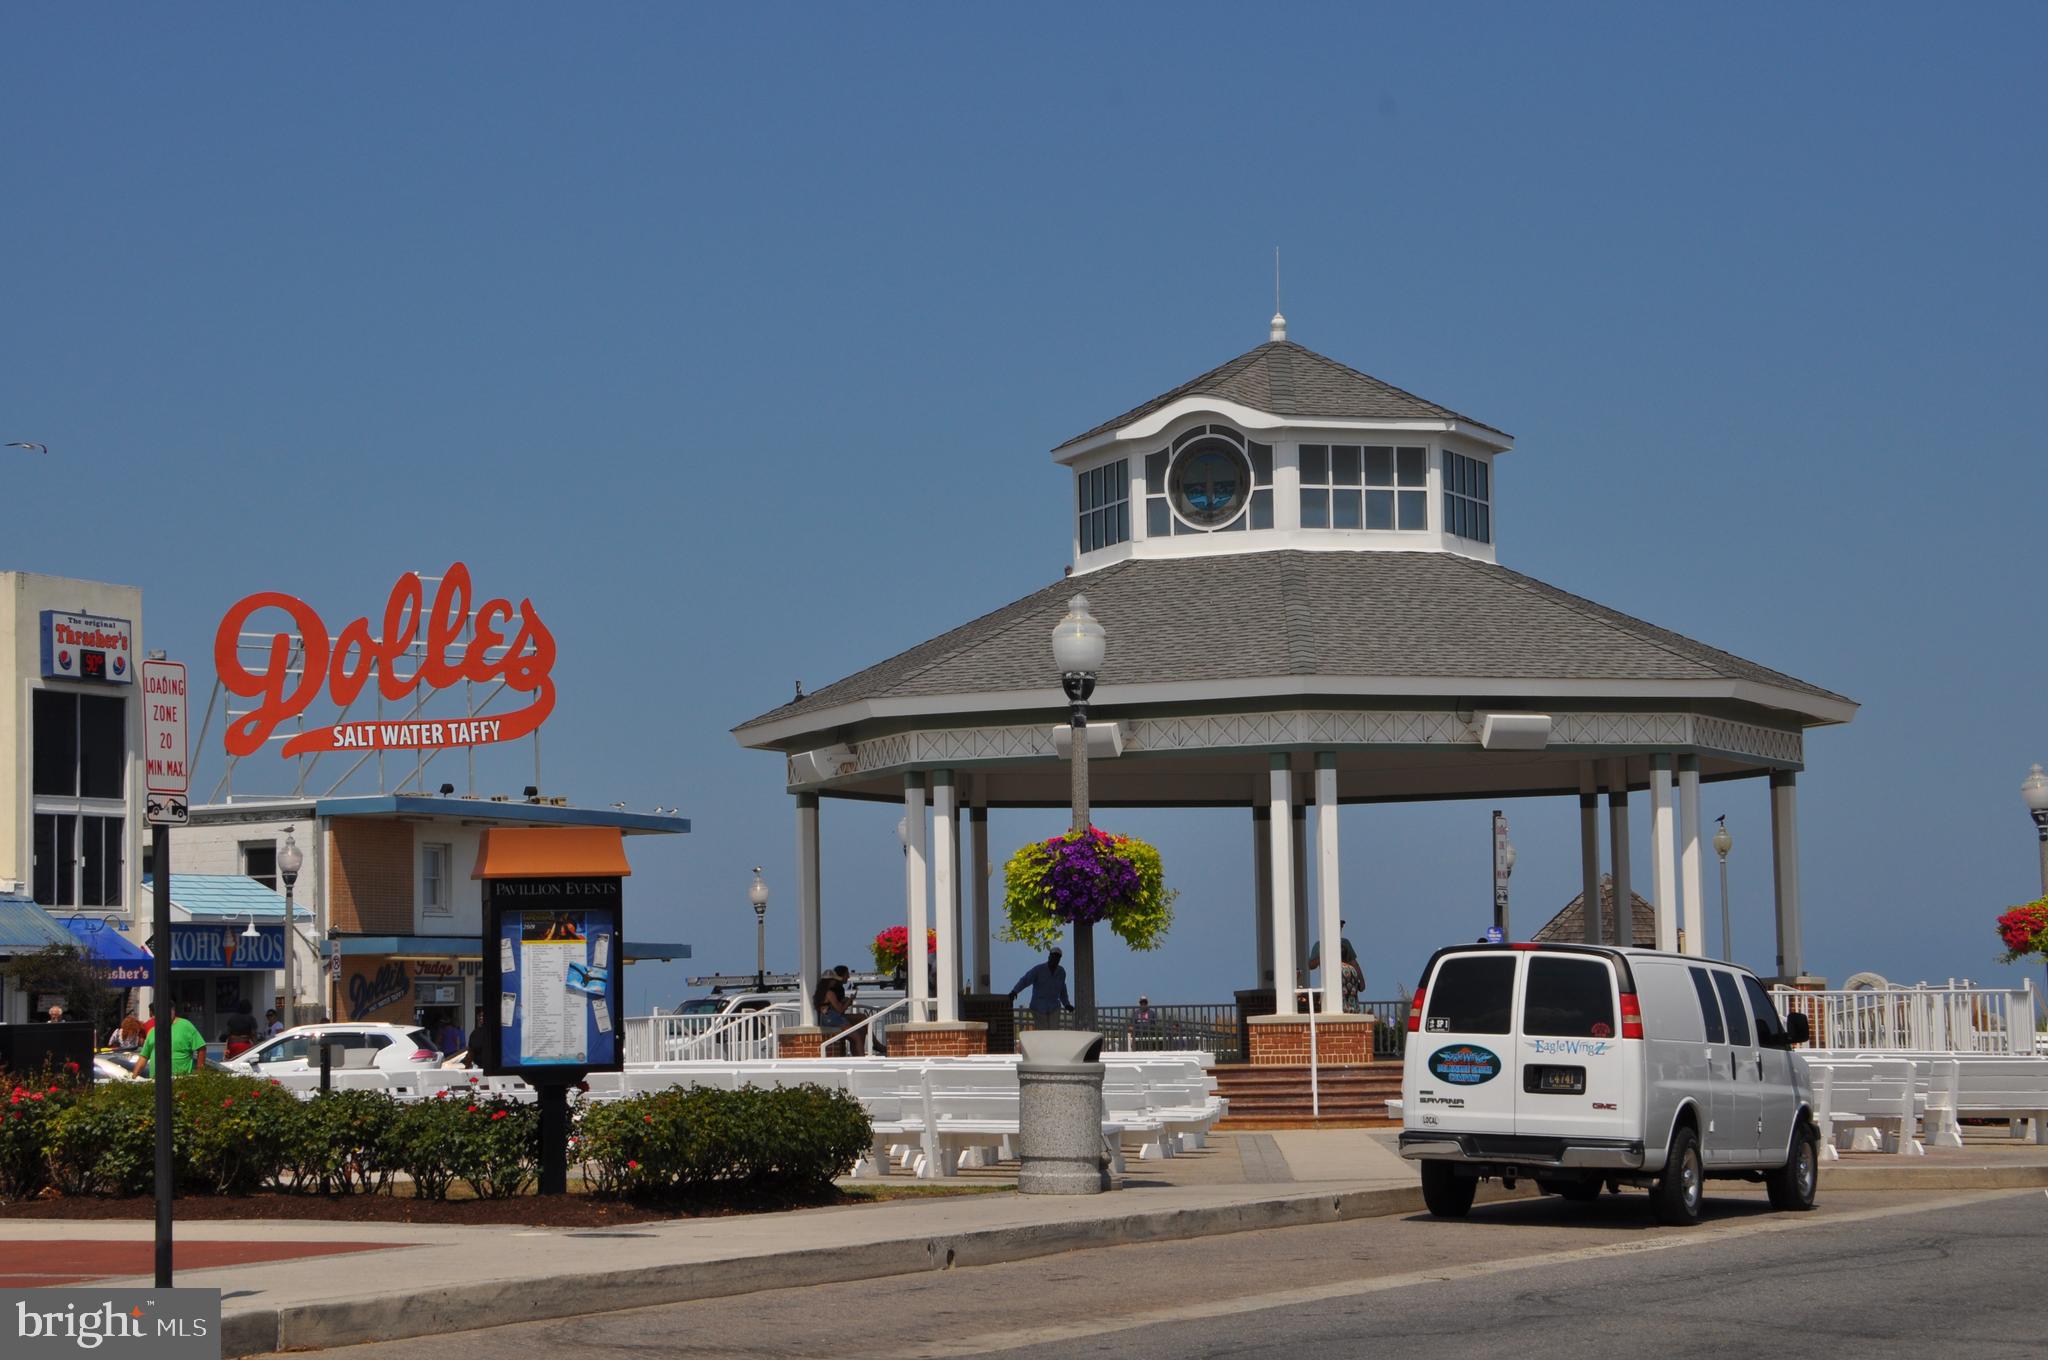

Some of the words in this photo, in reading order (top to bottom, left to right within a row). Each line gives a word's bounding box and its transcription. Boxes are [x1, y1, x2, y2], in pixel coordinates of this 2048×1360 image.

[67, 616, 82, 625] The
[84, 621, 116, 629] original
[56, 623, 128, 651] Thrasher's
[145, 676, 184, 697] LOADING
[153, 705, 178, 723] ZONE
[160, 732, 173, 750] 20
[333, 725, 376, 748] SALT
[381, 723, 445, 747] WATER
[447, 720, 501, 744] TAFFY
[147, 759, 166, 777] MIN.
[166, 760, 186, 778] MAX.
[496, 883, 562, 897] PAVILLION
[566, 881, 617, 895] EVENTS
[170, 931, 221, 962] KOHR
[235, 932, 284, 962] BROS
[415, 960, 454, 981] Fudge
[1419, 1097, 1464, 1105] SAVANA
[1592, 1102, 1617, 1110] GMC
